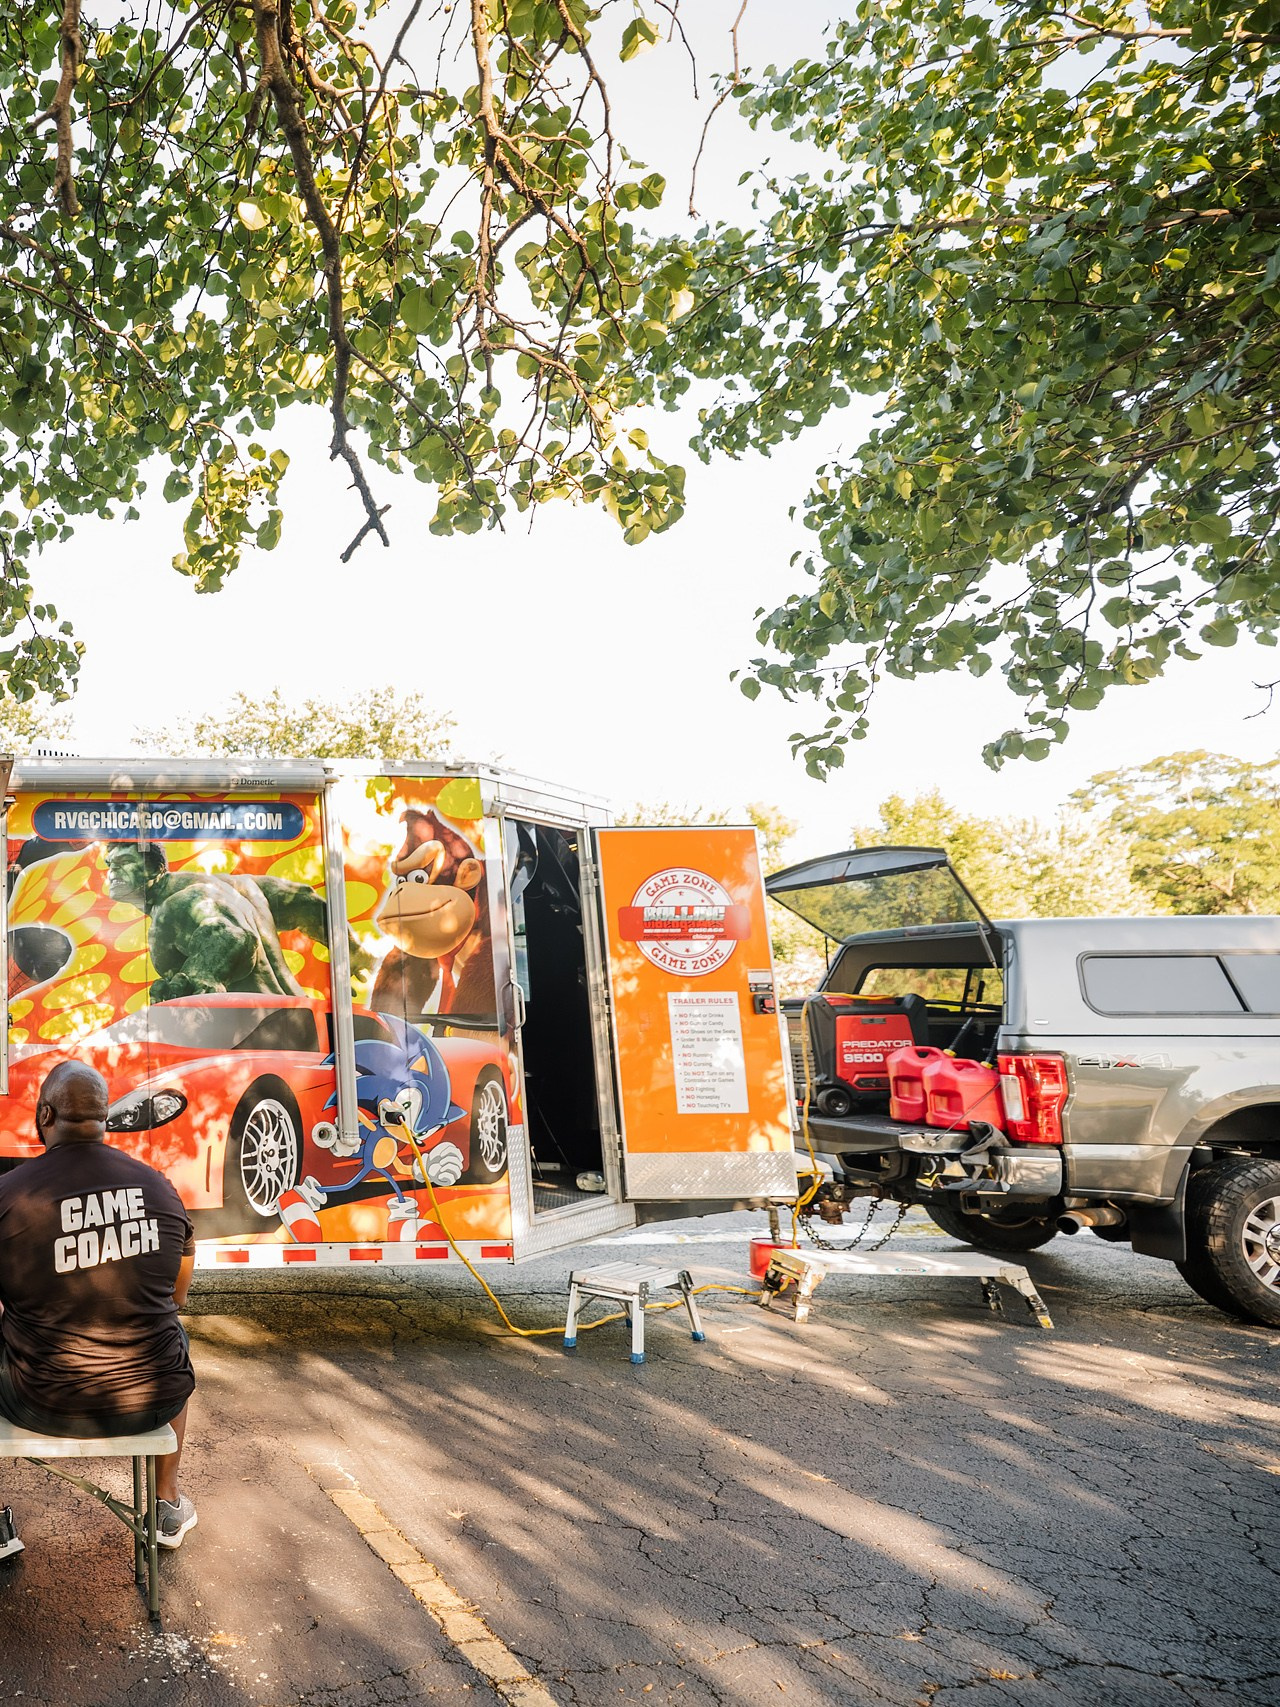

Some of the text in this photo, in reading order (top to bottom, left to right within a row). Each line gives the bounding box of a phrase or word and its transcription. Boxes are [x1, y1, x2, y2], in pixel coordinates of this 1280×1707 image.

[240, 777, 275, 786] Dometic
[54, 809, 283, 830] RVGCHICAGO@GMAIL.COM
[645, 874, 718, 897] GAME ZONE
[651, 946, 725, 970] GAME ZONE
[842, 1040, 912, 1049] PREDATOR
[843, 1053, 884, 1063] 9500
[61, 1188, 145, 1233] GAME
[54, 1219, 160, 1273] COACH
